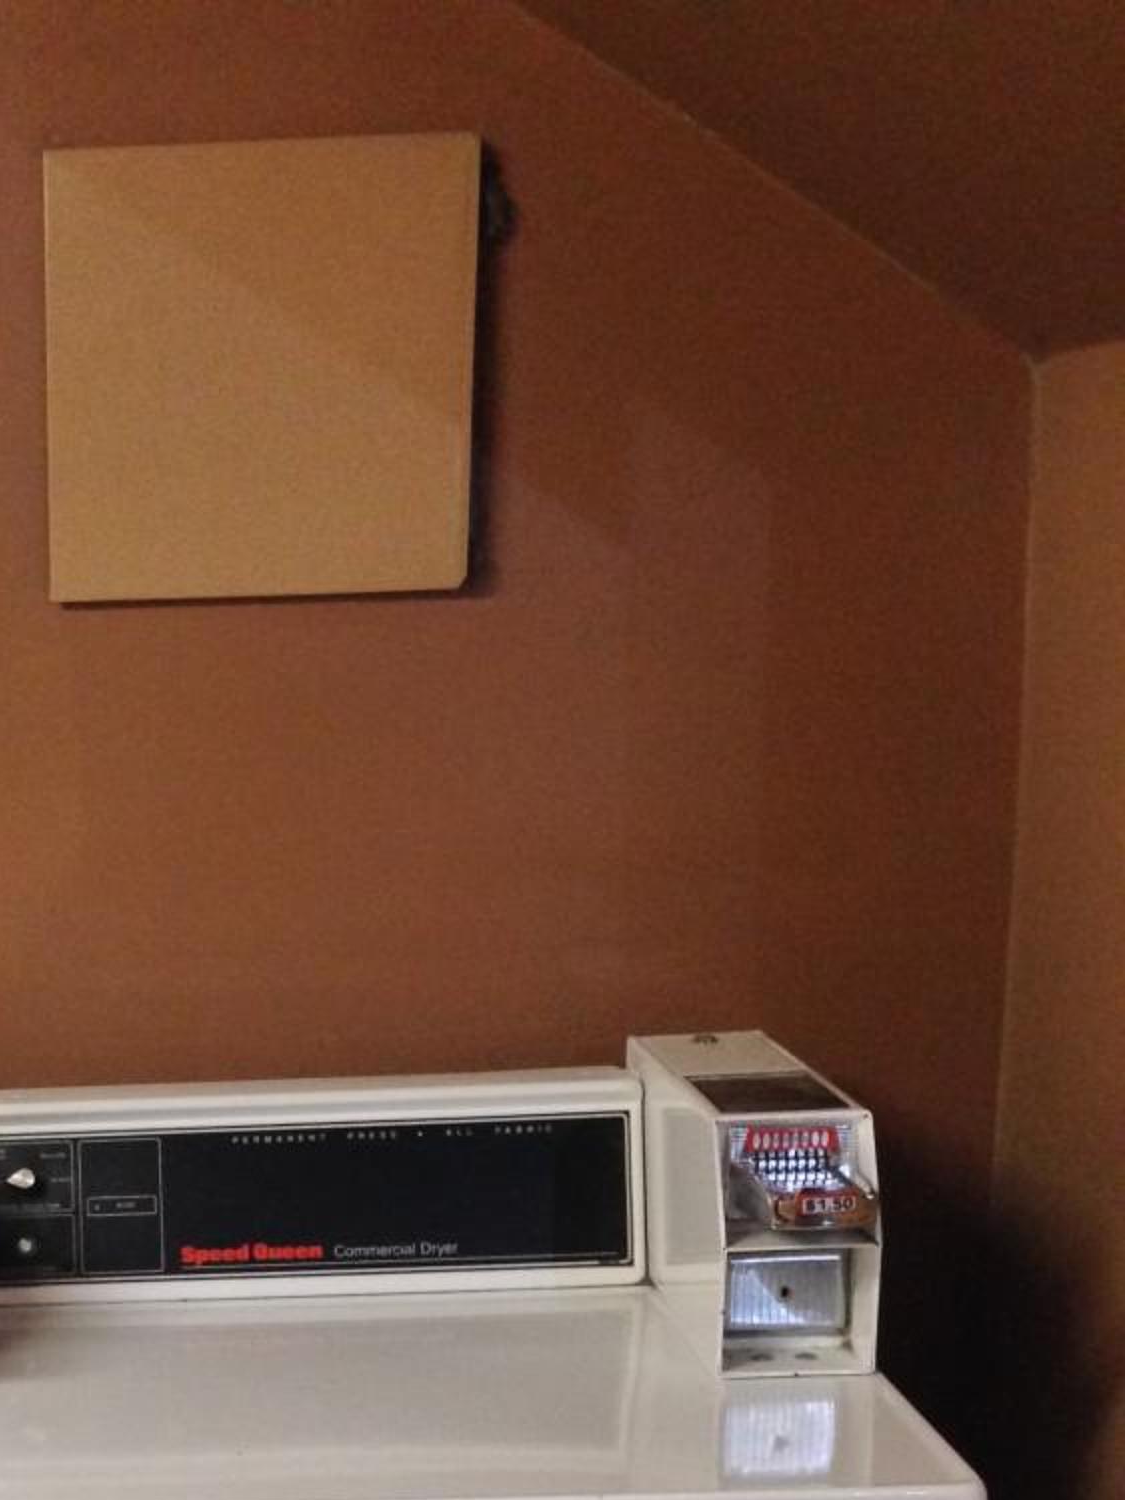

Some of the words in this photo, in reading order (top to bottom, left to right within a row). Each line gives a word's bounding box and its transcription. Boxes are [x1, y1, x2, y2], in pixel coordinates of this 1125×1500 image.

[806, 1197, 853, 1212] $1.50
[180, 1243, 250, 1265] Speed
[253, 1241, 324, 1261] Queen
[333, 1242, 416, 1259] Commercial
[420, 1240, 459, 1261] Dryer
